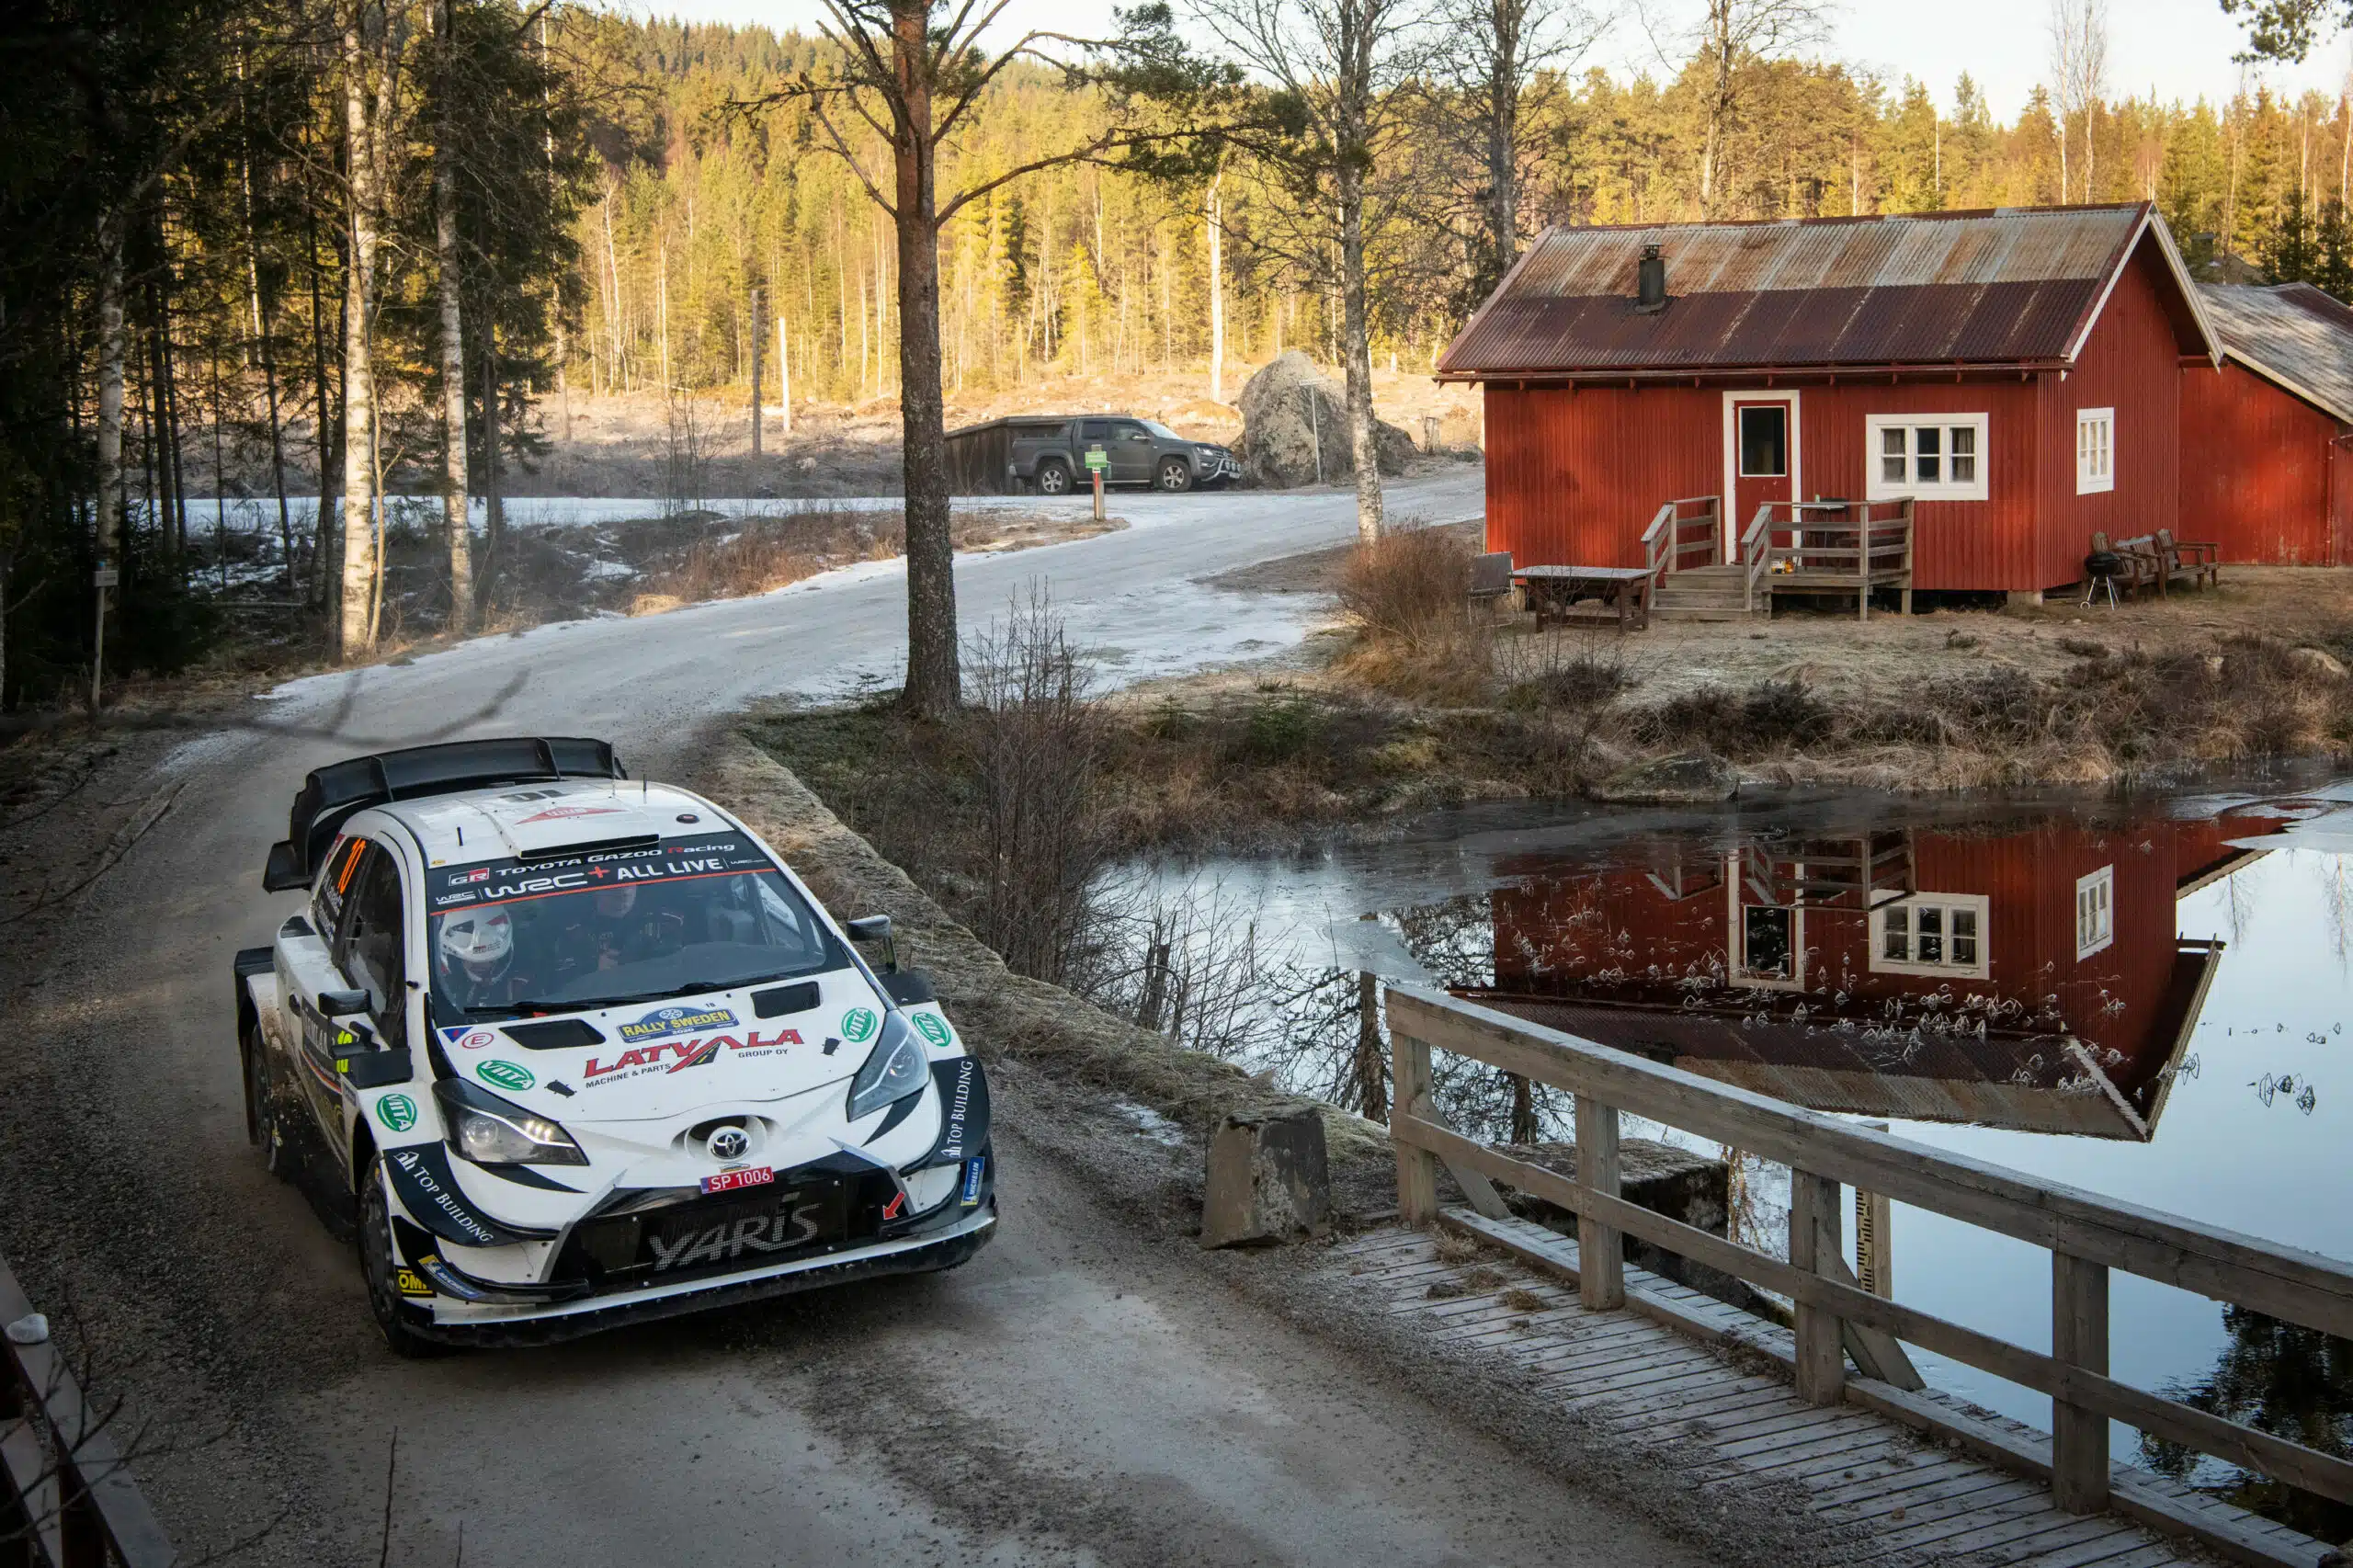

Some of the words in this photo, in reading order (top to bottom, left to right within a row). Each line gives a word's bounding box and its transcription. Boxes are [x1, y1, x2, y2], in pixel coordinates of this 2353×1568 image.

[495, 858, 582, 876] TOYOTA
[587, 849, 662, 863] GAZOO
[617, 864, 664, 881] ALL
[667, 858, 723, 874] LIVE
[621, 1021, 666, 1037] RALLY
[670, 1011, 732, 1028] SWEDEN
[583, 1028, 804, 1078] LATVALA
[585, 1072, 630, 1089] MACHINE
[631, 1069, 640, 1077] &
[641, 1062, 671, 1075] PARTS
[738, 1050, 773, 1059] GROUP
[951, 1061, 973, 1122] BUILDING
[947, 1123, 963, 1146] TOP
[710, 1176, 731, 1190] SP
[736, 1168, 770, 1187] 1006
[969, 1162, 980, 1196] MICHELIN
[413, 1166, 439, 1194] TOP
[435, 1193, 495, 1243] BUILDING
